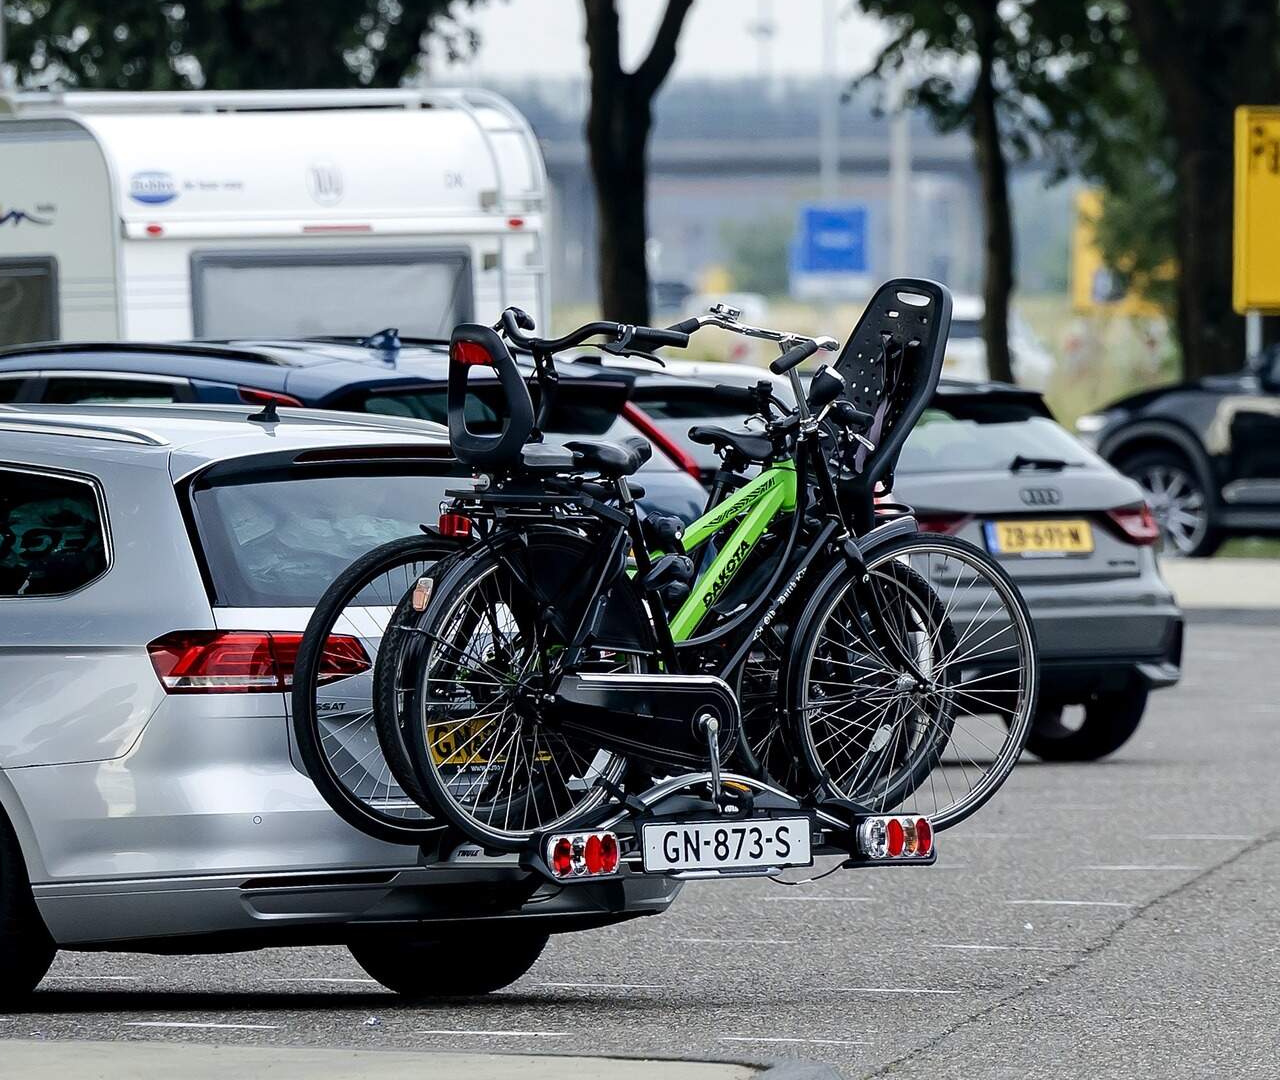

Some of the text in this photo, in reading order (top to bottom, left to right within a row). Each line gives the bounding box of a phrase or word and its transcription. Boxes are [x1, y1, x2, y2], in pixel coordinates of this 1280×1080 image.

[703, 540, 750, 608] DAKOTA
[316, 702, 346, 711] SSAT
[663, 826, 791, 863] GN-873-S
